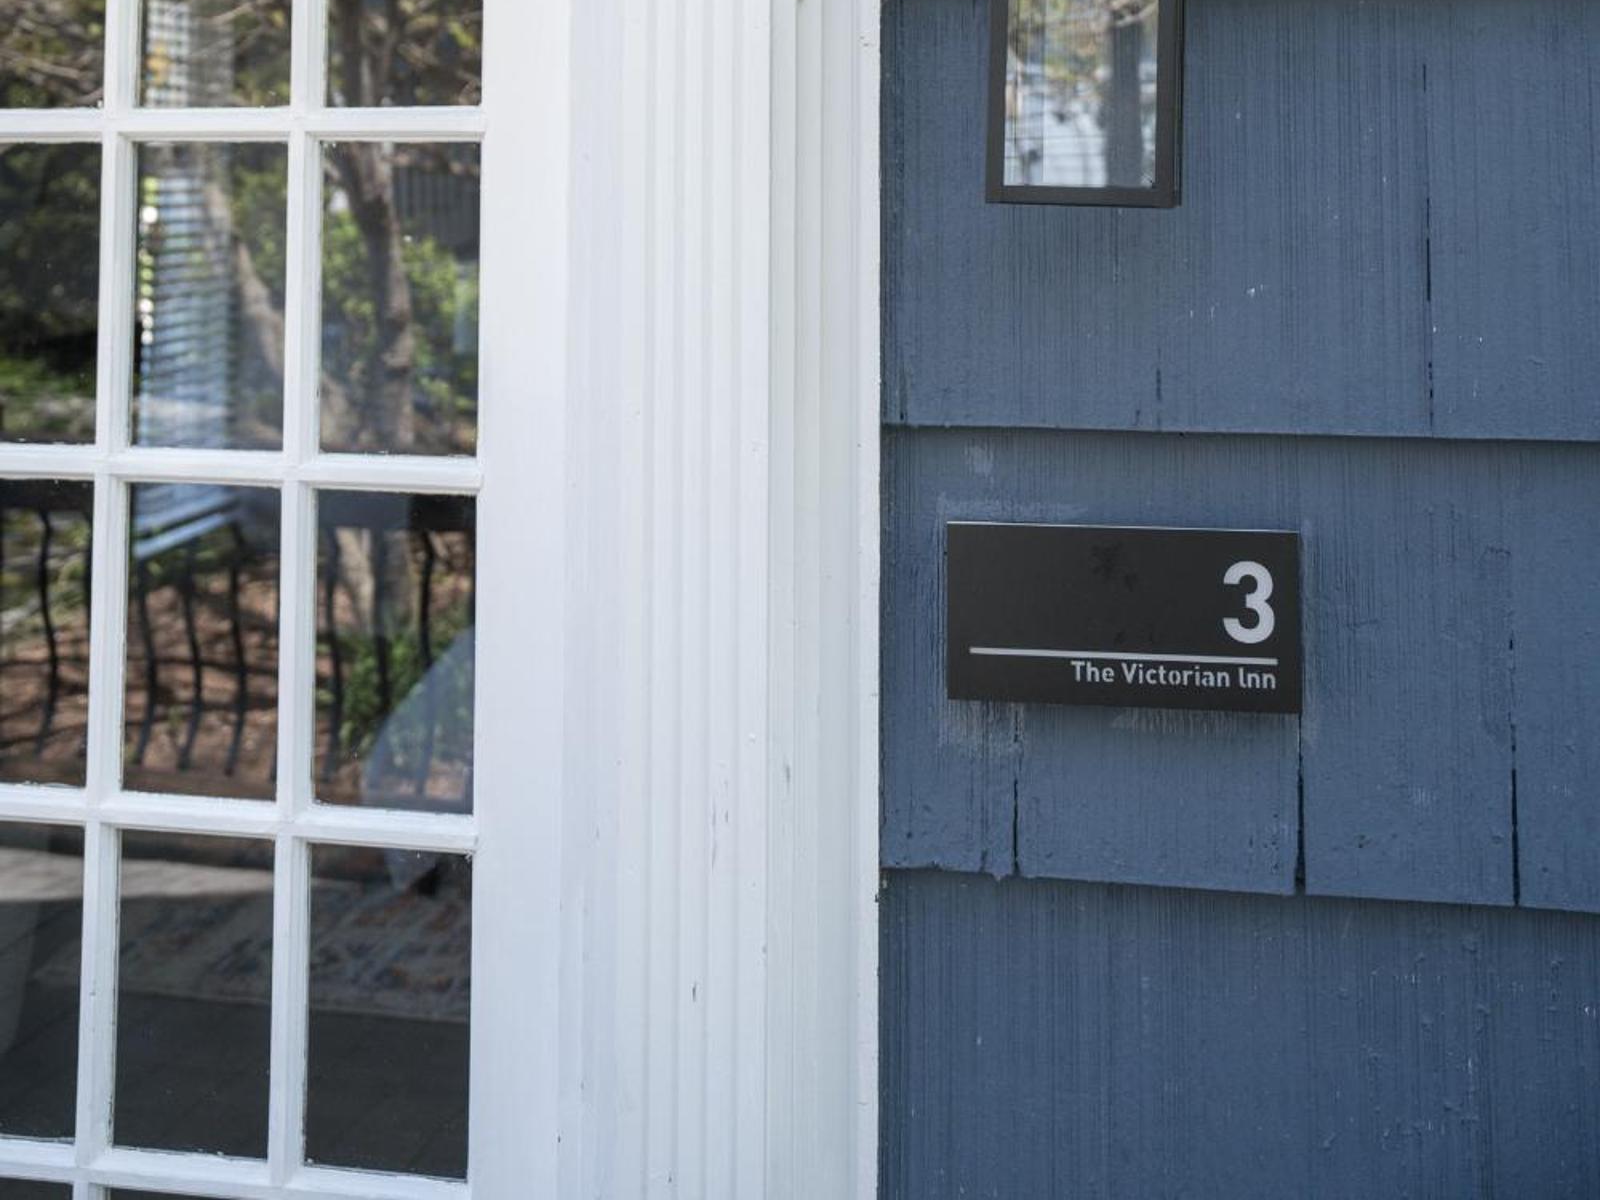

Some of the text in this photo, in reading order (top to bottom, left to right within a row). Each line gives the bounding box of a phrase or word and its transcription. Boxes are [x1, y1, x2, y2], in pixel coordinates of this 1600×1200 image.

[1222, 560, 1276, 645] 3
[1070, 660, 1277, 690] The Victorian Inn
